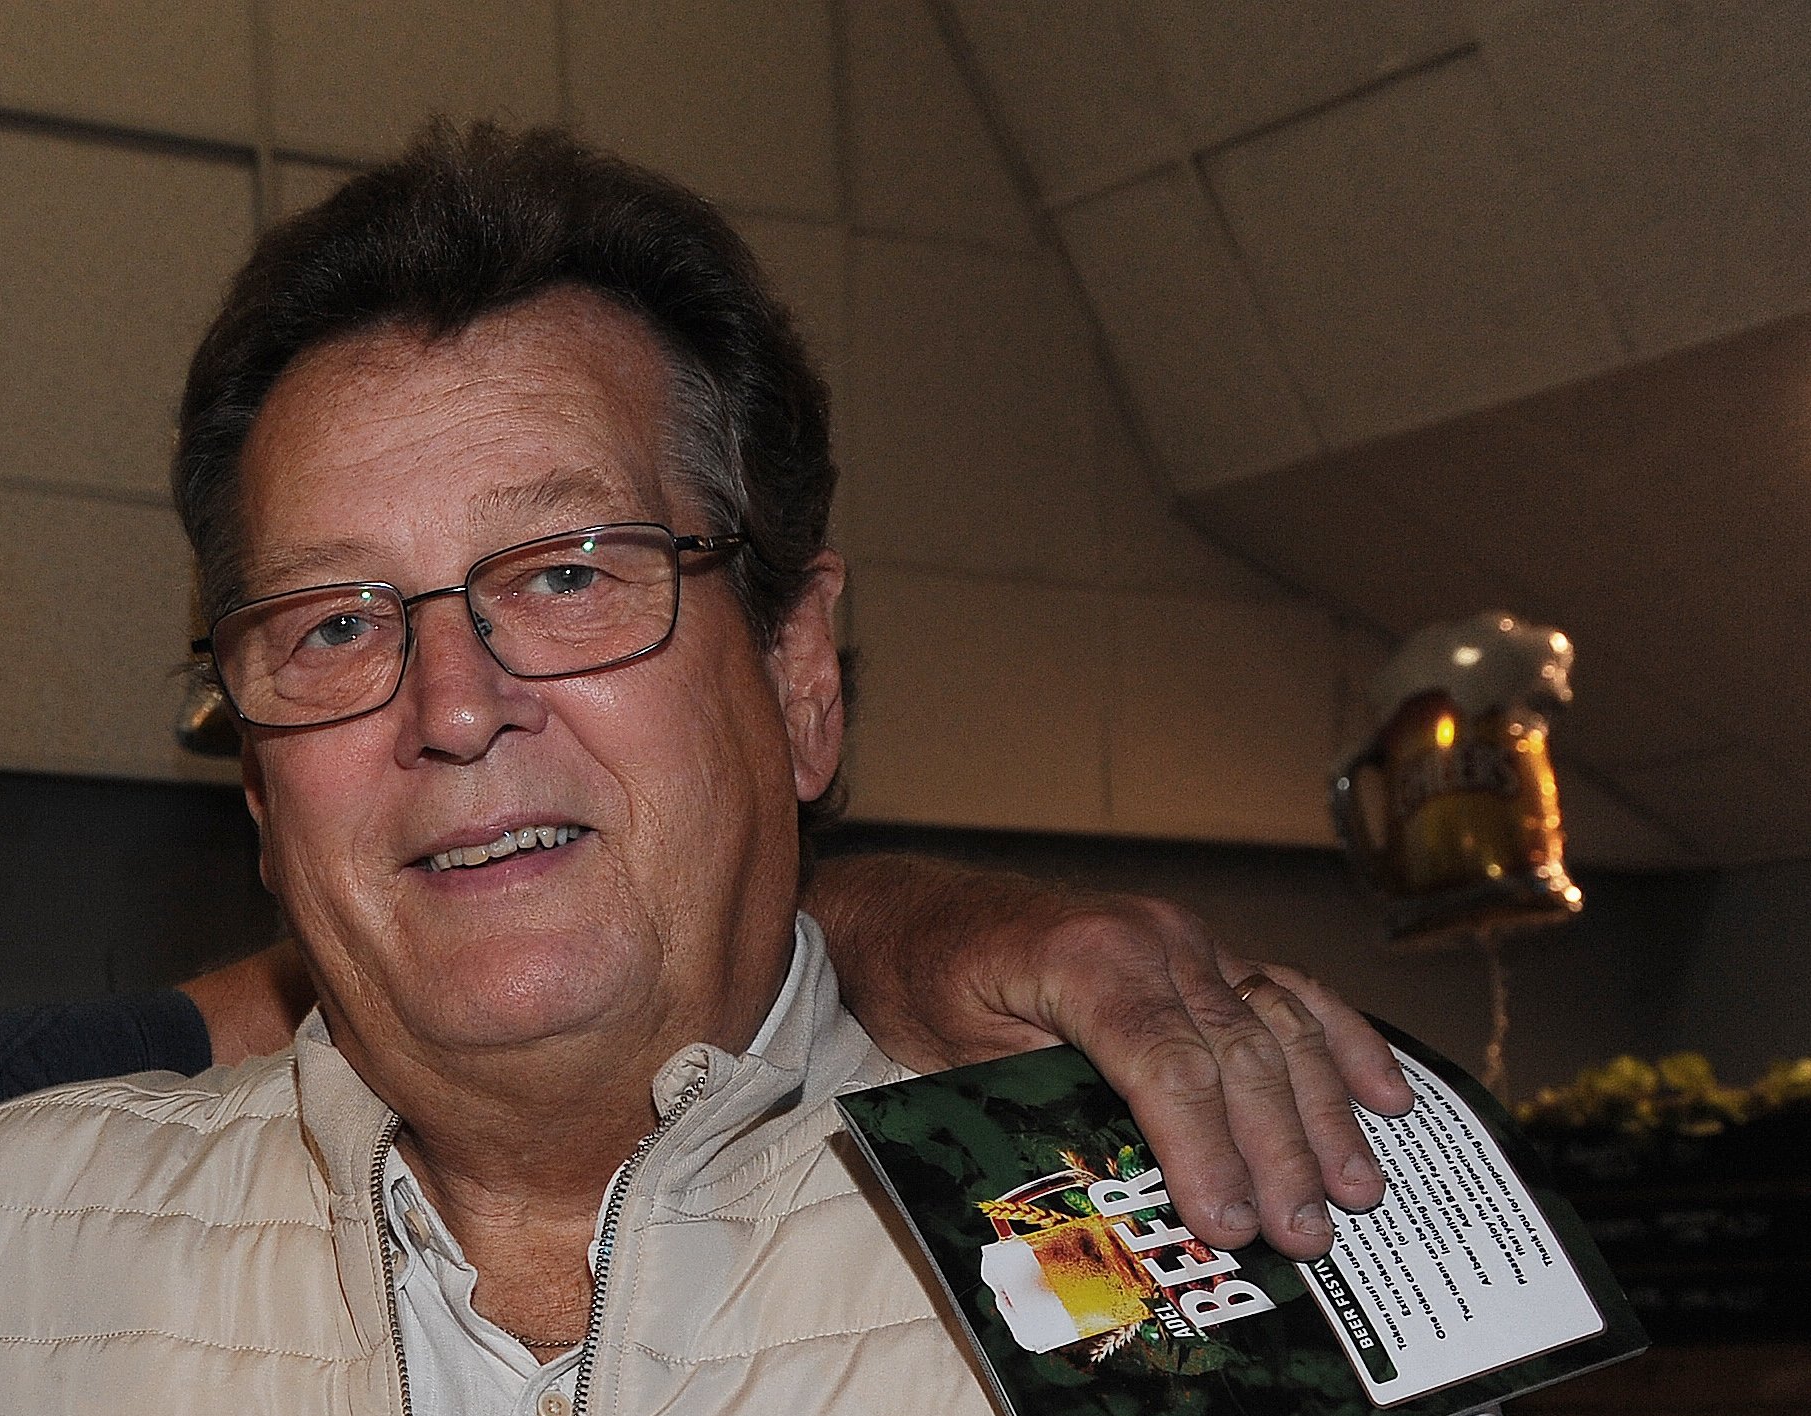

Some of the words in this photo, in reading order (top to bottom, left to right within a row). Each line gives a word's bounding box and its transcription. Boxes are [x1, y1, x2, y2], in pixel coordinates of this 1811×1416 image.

[1422, 1082, 1445, 1102] Beer
[1383, 1116, 1398, 1132] ser
[1431, 1115, 1448, 1132] our
[1440, 1101, 1464, 1123] Adel
[1394, 1133, 1407, 1148] be
[1398, 1118, 1416, 1139] Glas
[1412, 1109, 1455, 1165] responsibly
[1445, 1133, 1456, 1145] to
[1459, 1123, 1475, 1140] the
[1372, 1135, 1392, 1157] fruit
[1385, 1158, 1405, 1178] and
[1402, 1148, 1424, 1173] must
[1411, 1139, 1441, 1179] Festival
[1450, 1145, 1489, 1195] respectful
[1471, 1140, 1512, 1197] supporting
[1400, 1179, 1421, 1205] tonic
[1419, 1174, 1443, 1206] drinks
[1436, 1179, 1456, 1203] Beer
[1448, 1165, 1478, 1203] festival
[1450, 1203, 1473, 1228] Adel
[1474, 1203, 1490, 1221] the
[1485, 1196, 1500, 1213] are
[1506, 1197, 1522, 1213] for
[1349, 1217, 1362, 1233] be
[1368, 1212, 1394, 1249] exchan
[1382, 1209, 1398, 1230] two
[1416, 1205, 1451, 1255] including
[1437, 1207, 1467, 1244] festival
[1496, 1214, 1515, 1235] you
[1518, 1214, 1537, 1234] you
[1329, 1230, 1345, 1243] to
[1357, 1232, 1373, 1251] can
[1394, 1231, 1410, 1246] (or
[1414, 1226, 1428, 1242] be
[1485, 1222, 1507, 1250] enjoy
[1507, 1235, 1526, 1257] that
[1087, 1166, 1278, 1329] BEER
[1338, 1243, 1361, 1269] used
[1390, 1249, 1404, 1265] be
[1424, 1241, 1439, 1260] can
[1462, 1245, 1482, 1271] beer
[1530, 1234, 1553, 1268] Thank
[1357, 1270, 1370, 1285] be
[1369, 1252, 1395, 1289] Tokens
[1400, 1264, 1415, 1283] can
[1435, 1261, 1460, 1297] tokens
[1476, 1270, 1493, 1286] All
[1504, 1251, 1528, 1285] Please
[1365, 1285, 1387, 1312] must
[1391, 1288, 1412, 1317] Extra
[1411, 1284, 1434, 1315] token
[1456, 1297, 1474, 1322] Two
[1153, 1301, 1196, 1339] ADEL
[1343, 1308, 1374, 1350] BEER
[1382, 1312, 1408, 1351] Tokens
[1430, 1316, 1446, 1340] One
